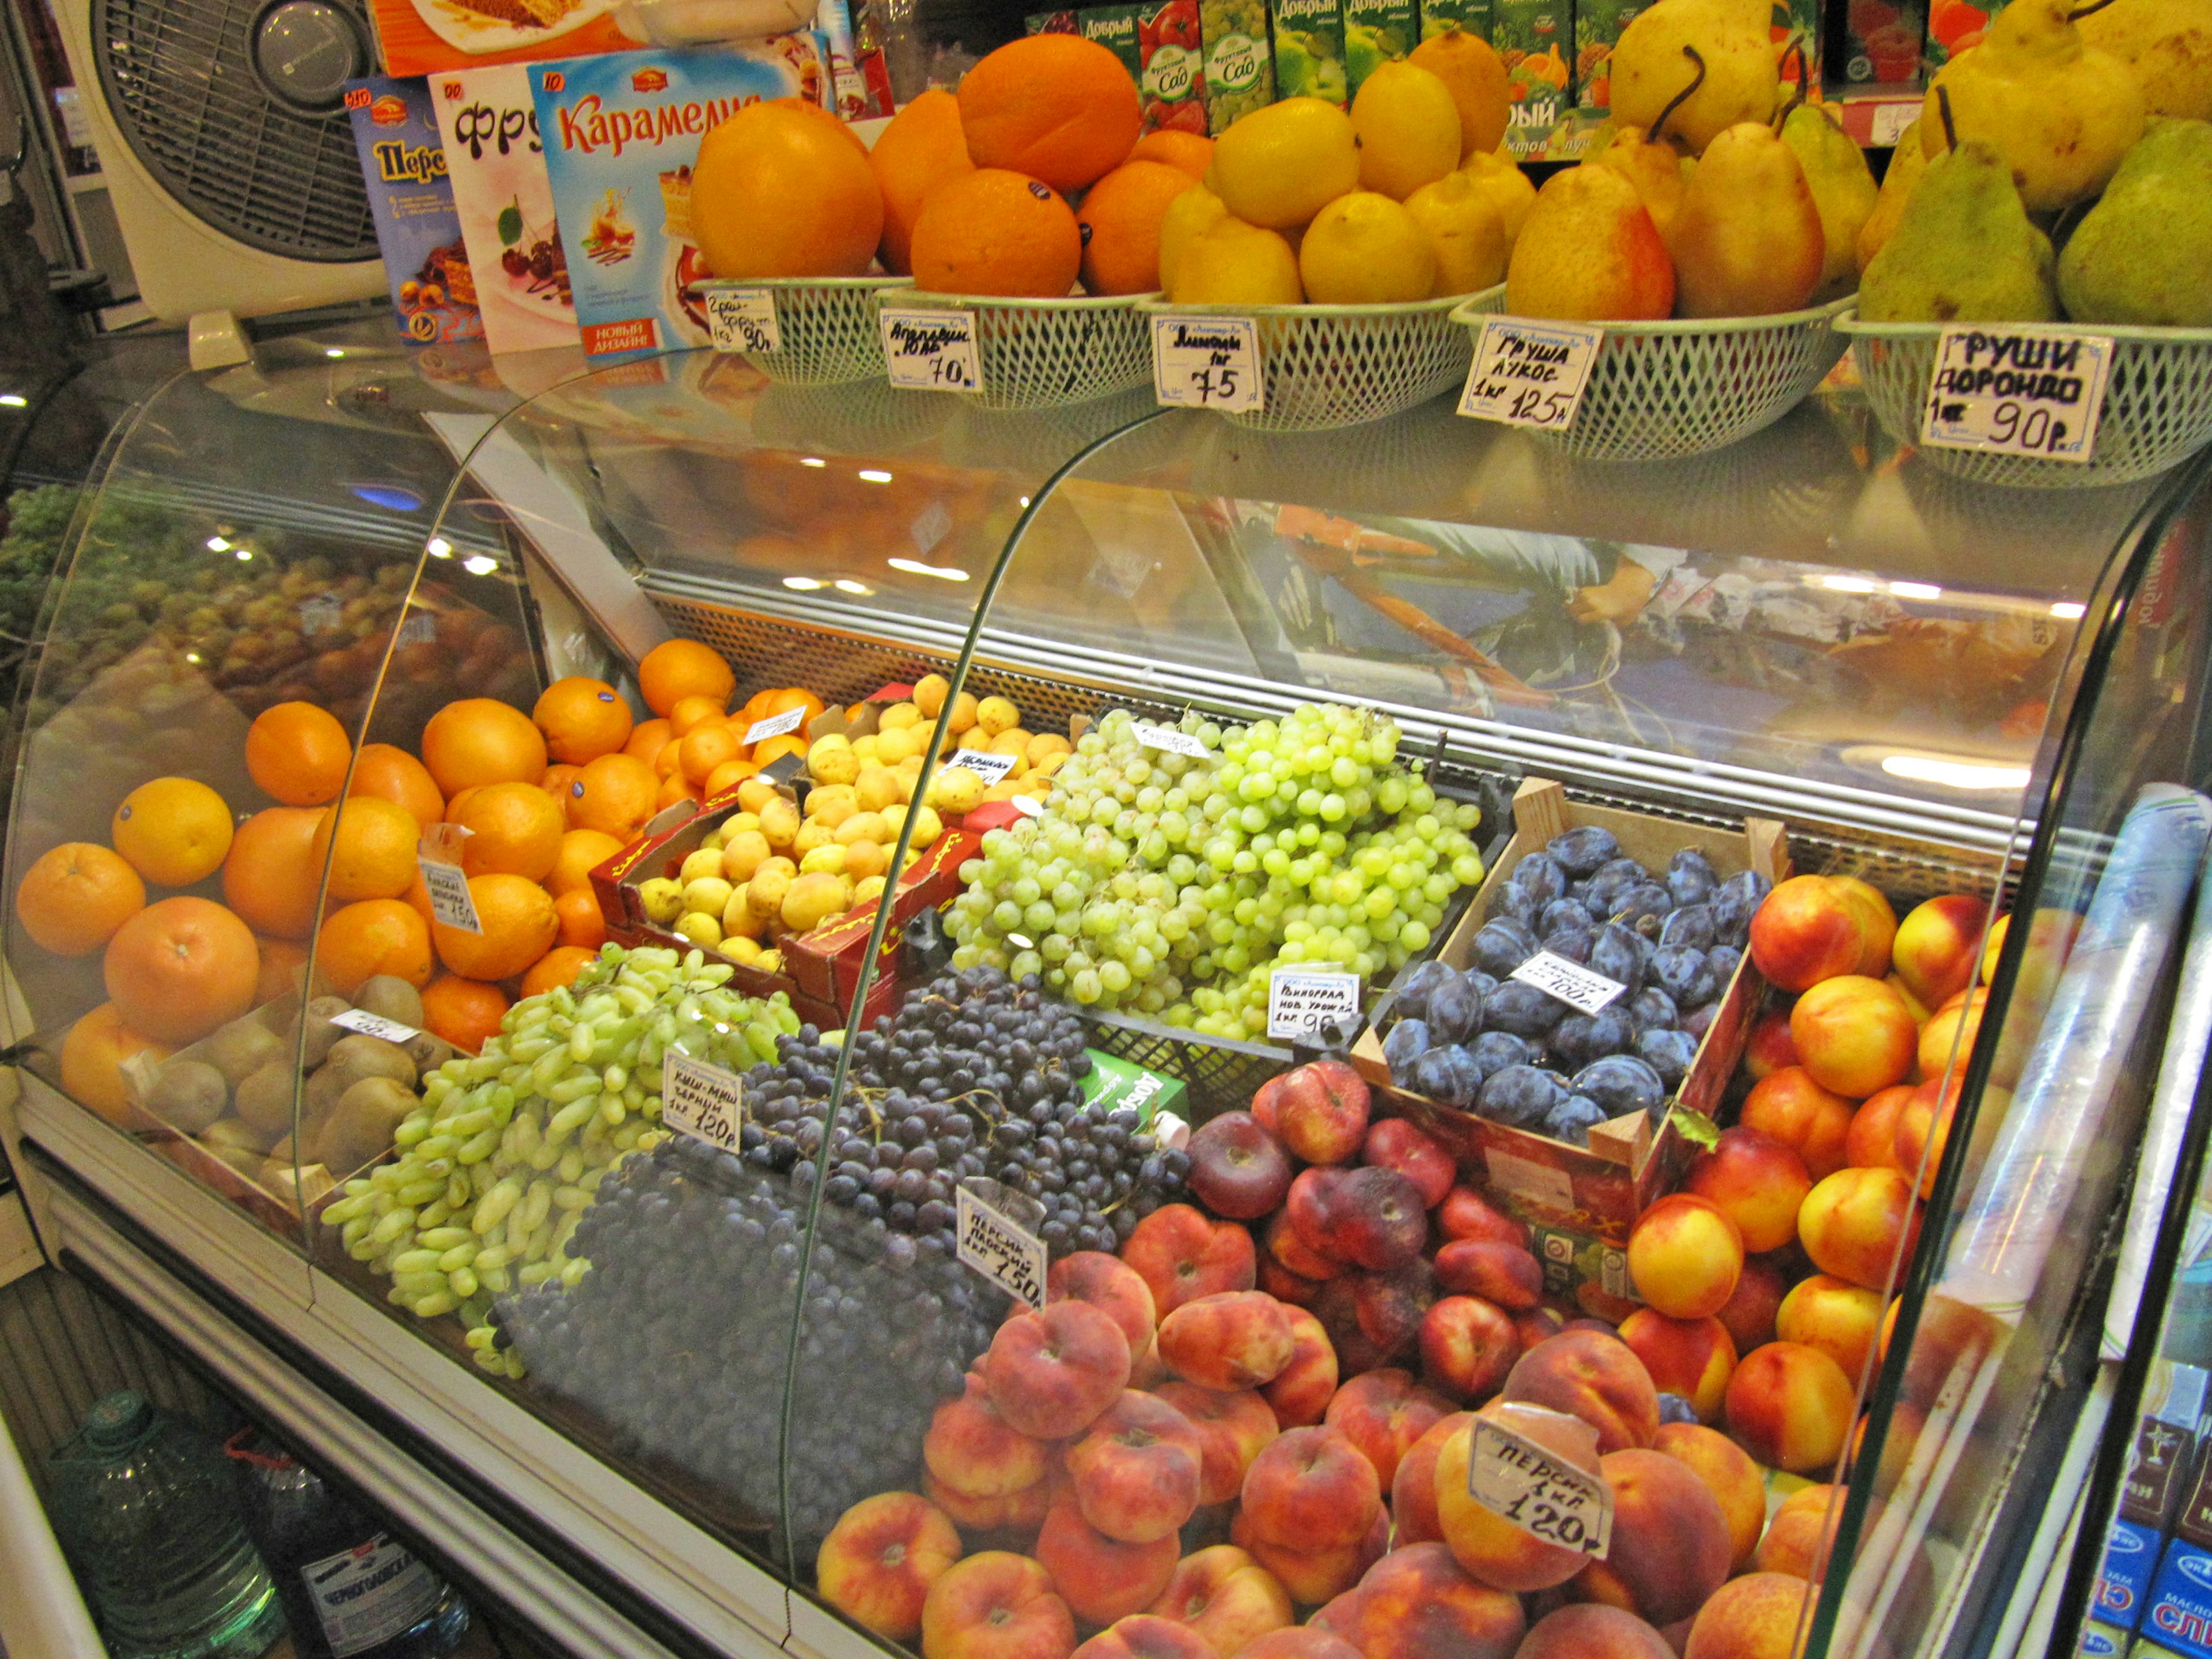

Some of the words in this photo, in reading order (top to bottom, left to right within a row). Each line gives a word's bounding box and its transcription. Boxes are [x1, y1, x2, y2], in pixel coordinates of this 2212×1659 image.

[1159, 66, 1188, 93] Сад
[1224, 55, 1255, 82] Сад
[596, 321, 643, 338] НОВЫЙ
[593, 335, 647, 354] ДИЗАЙН!
[1496, 335, 1570, 364] ГРУША
[1944, 331, 2081, 372] ГРУШИ
[1191, 369, 1238, 403] 75
[1934, 367, 2083, 404] ДОРОНДО
[1281, 984, 1344, 1000] ВИНОГРАД
[1108, 1071, 1164, 1117] Добр
